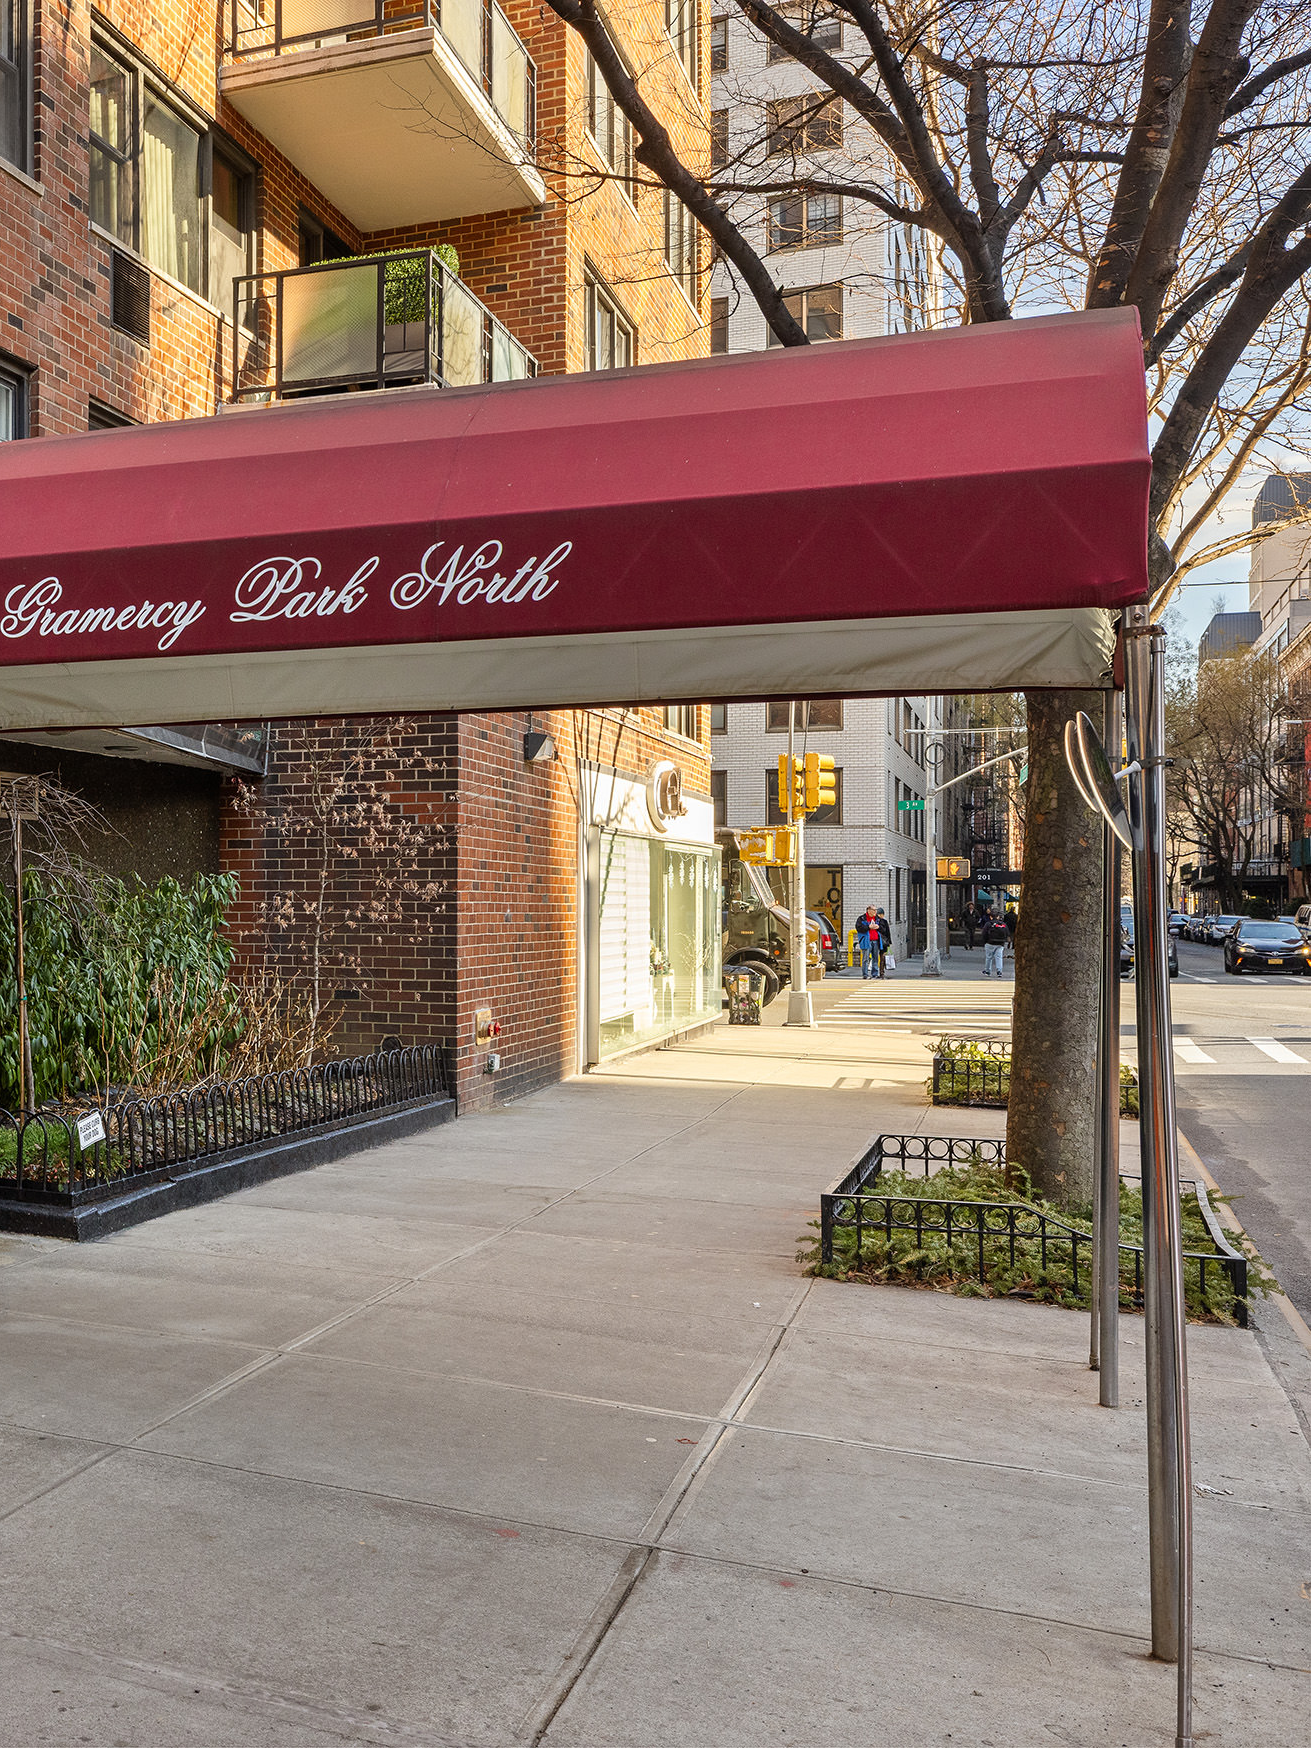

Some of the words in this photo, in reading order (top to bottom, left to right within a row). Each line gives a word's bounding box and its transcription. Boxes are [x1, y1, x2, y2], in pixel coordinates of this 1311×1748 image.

[0, 576, 206, 651] Gramercy
[229, 555, 380, 623] Park
[390, 539, 573, 611] North
